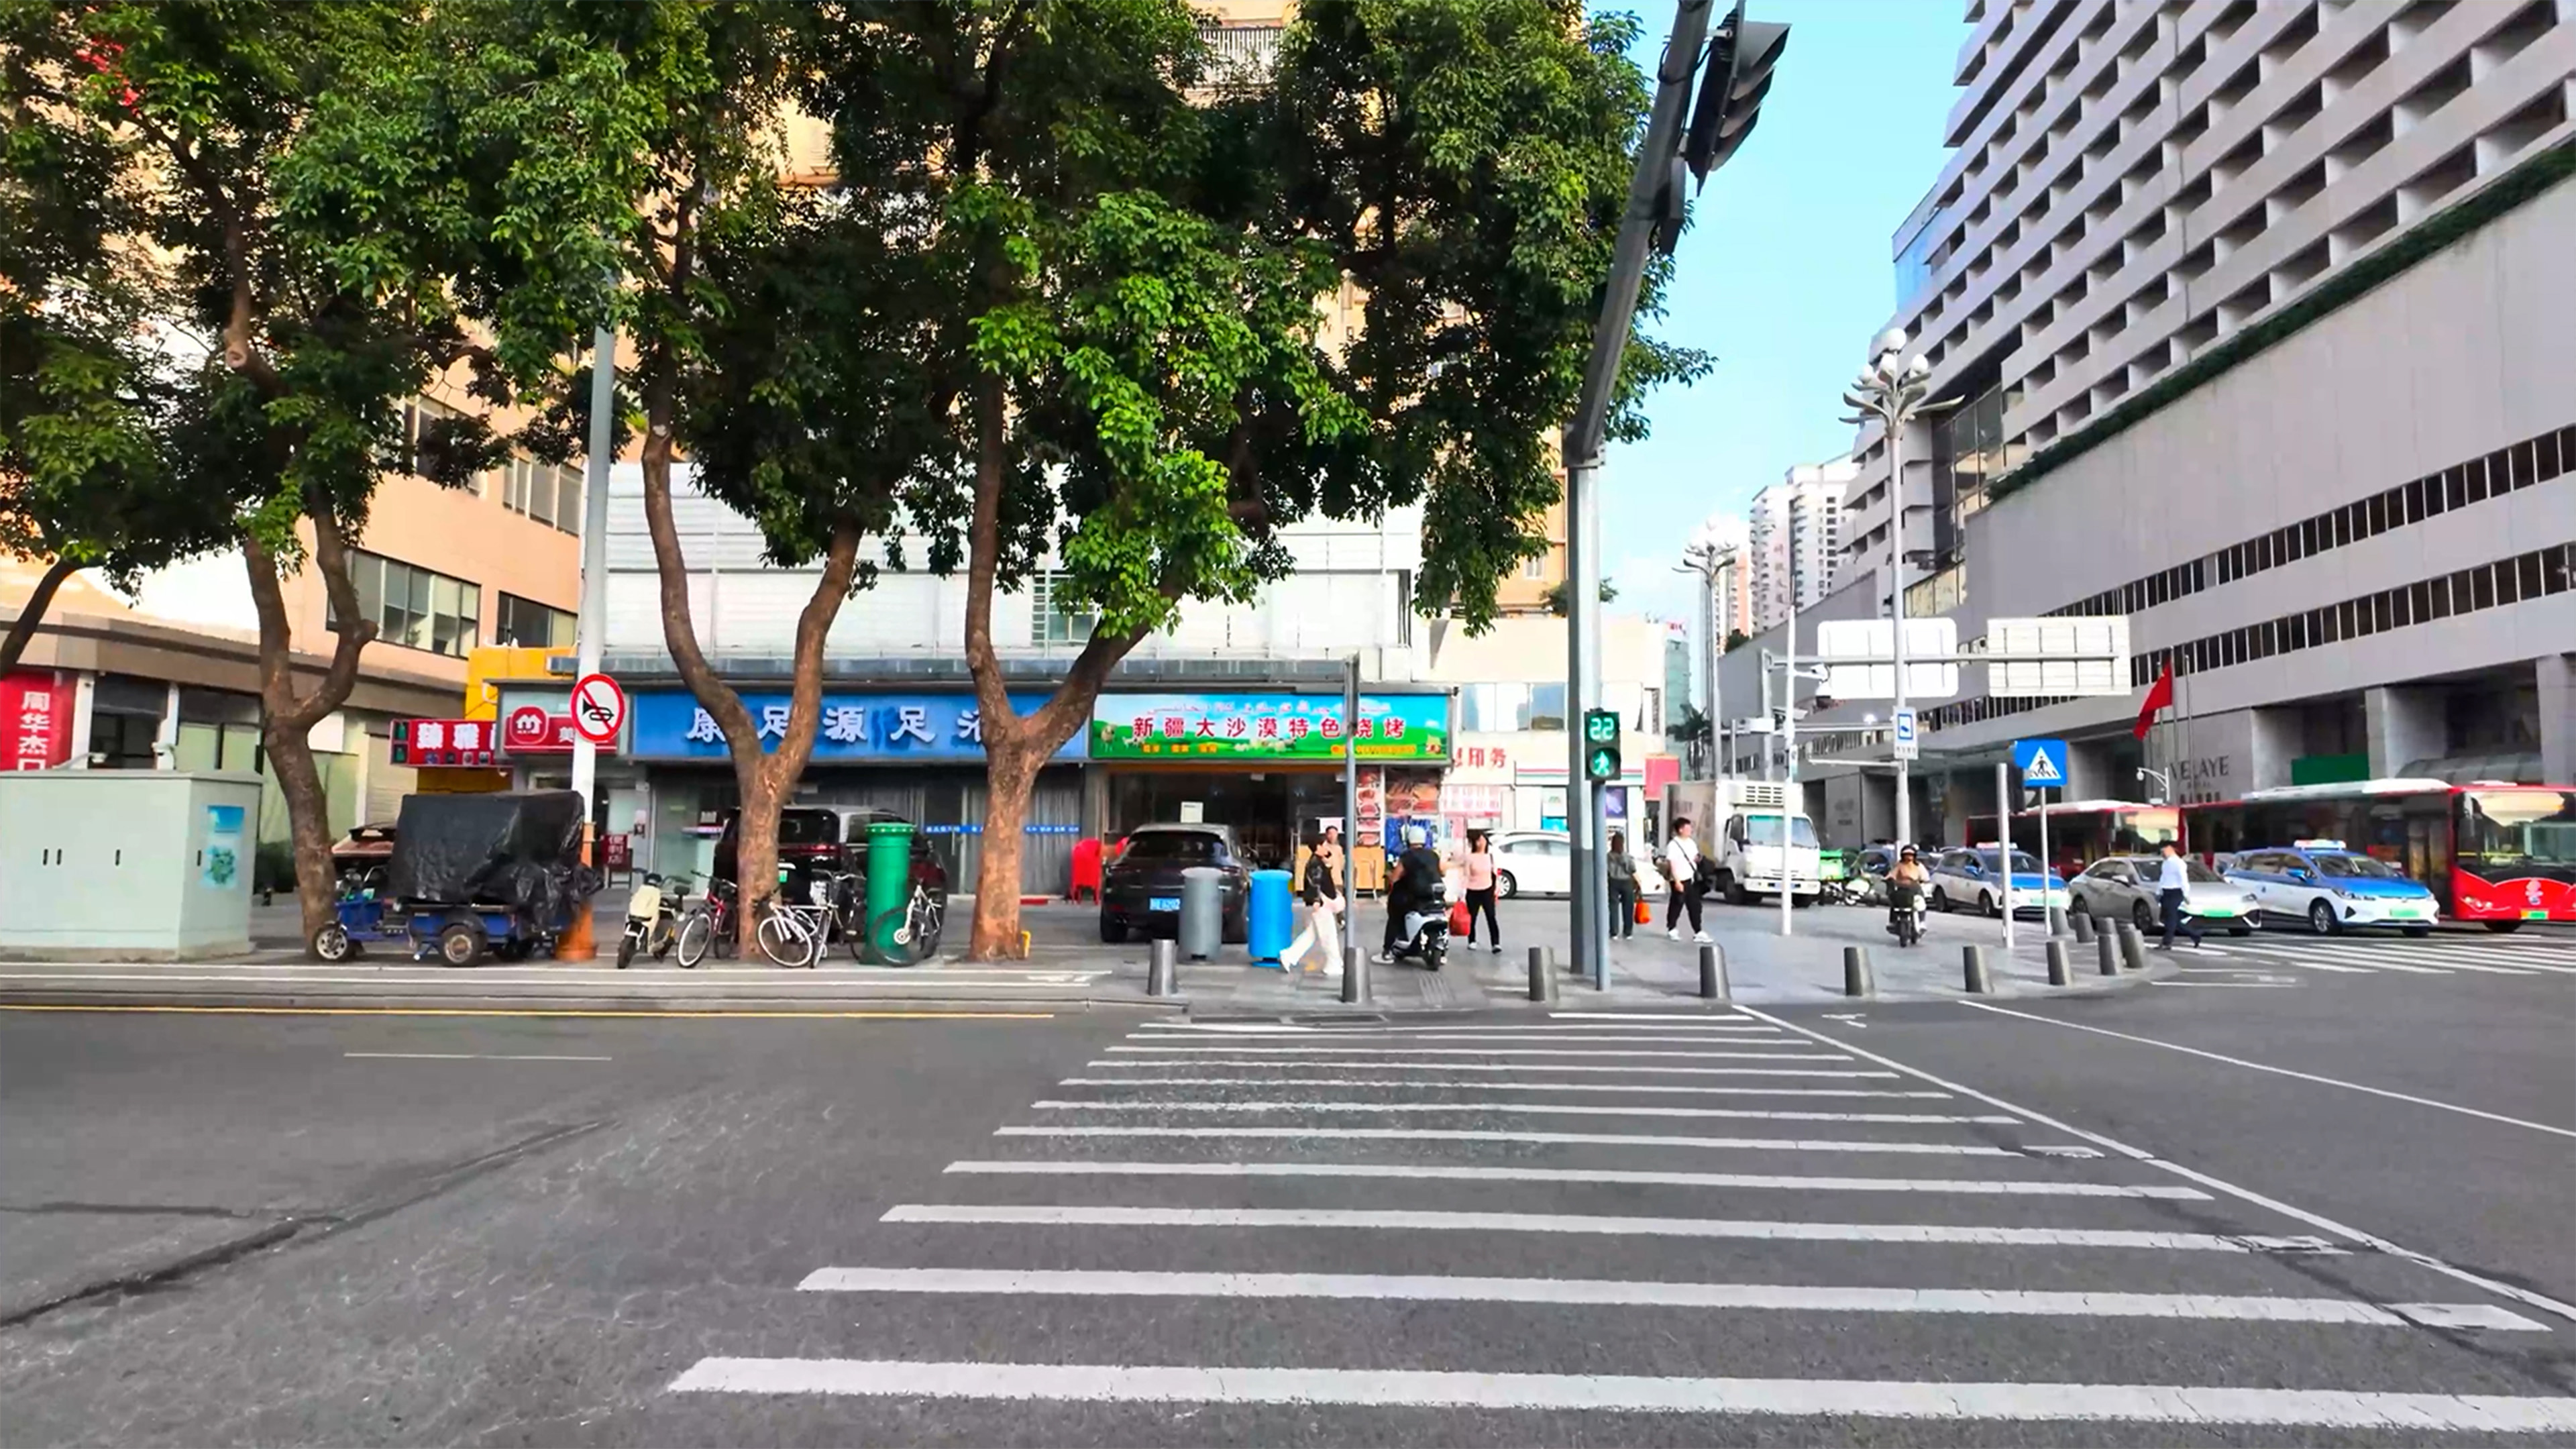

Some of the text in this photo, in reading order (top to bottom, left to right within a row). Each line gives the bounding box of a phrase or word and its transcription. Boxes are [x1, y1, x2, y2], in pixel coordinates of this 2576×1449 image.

[1133, 716, 1406, 738] 新疆大沙漠特色烧烤
[1589, 716, 1614, 741] 22
